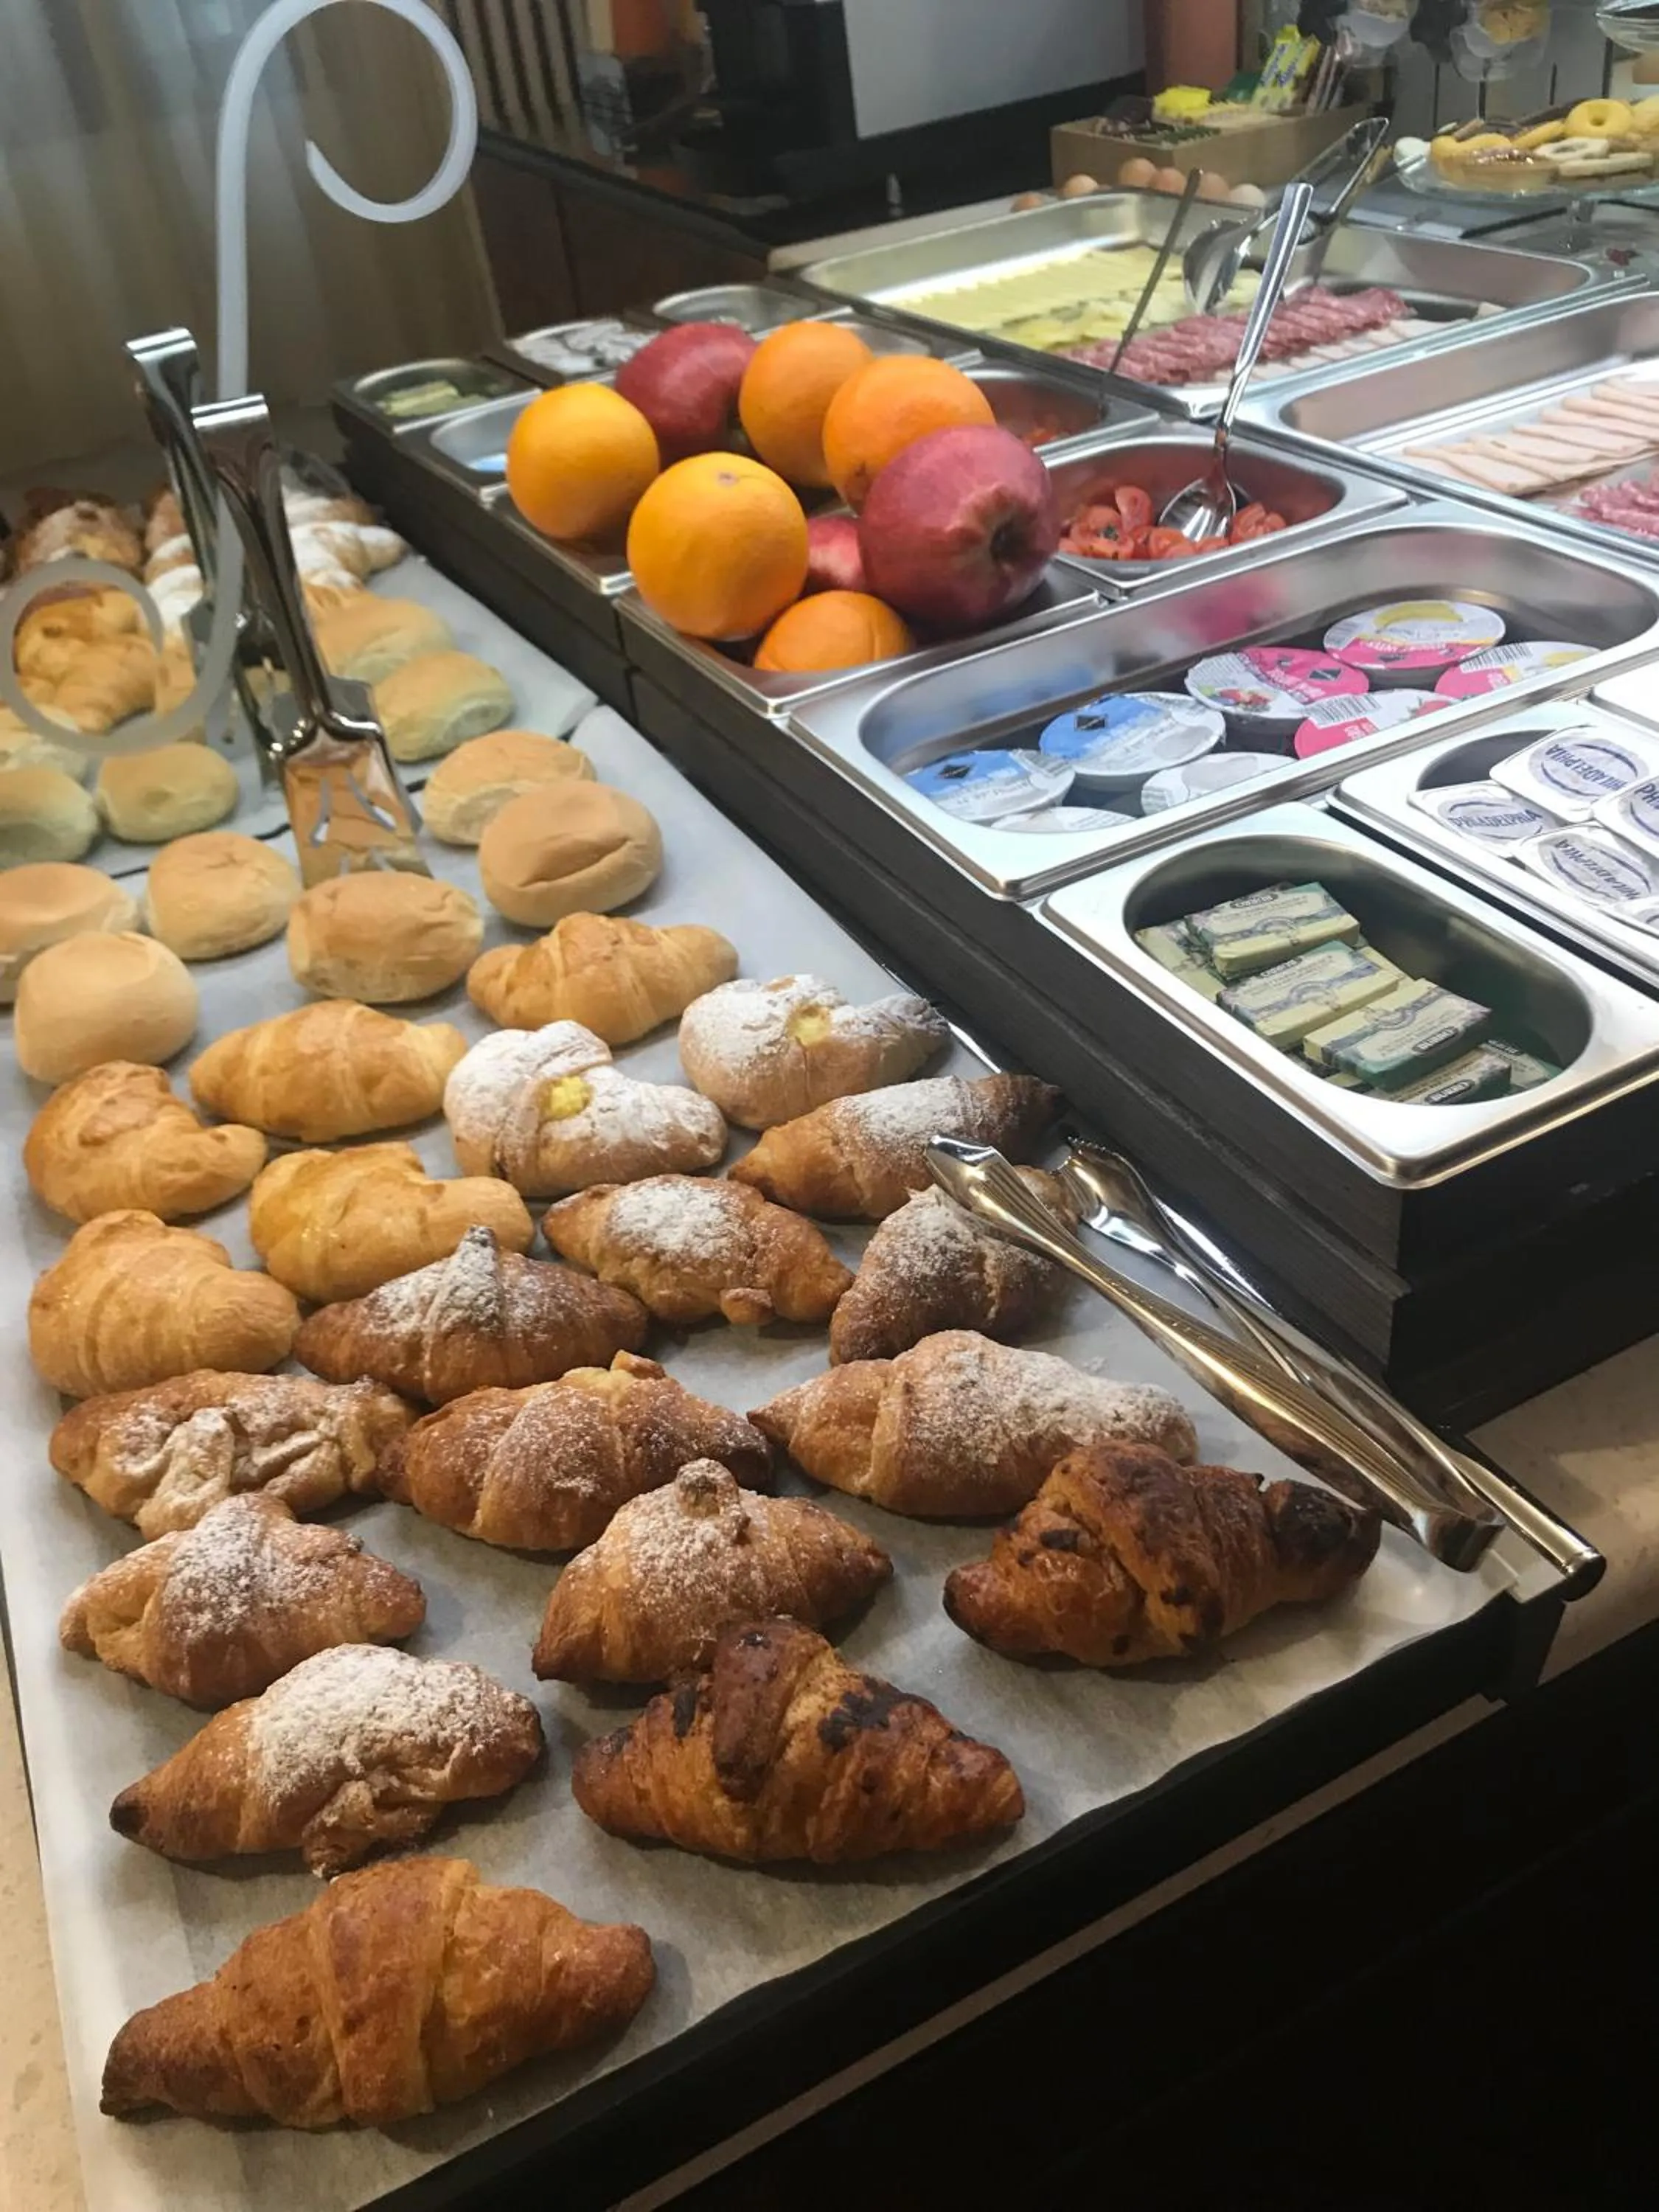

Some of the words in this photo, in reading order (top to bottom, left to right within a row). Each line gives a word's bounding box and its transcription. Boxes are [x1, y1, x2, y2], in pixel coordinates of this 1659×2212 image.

[1545, 744, 1629, 791] HILADELPHIA
[1448, 809, 1543, 828] PHILADELPHIA
[1554, 838, 1641, 900] HILADELPHIA
